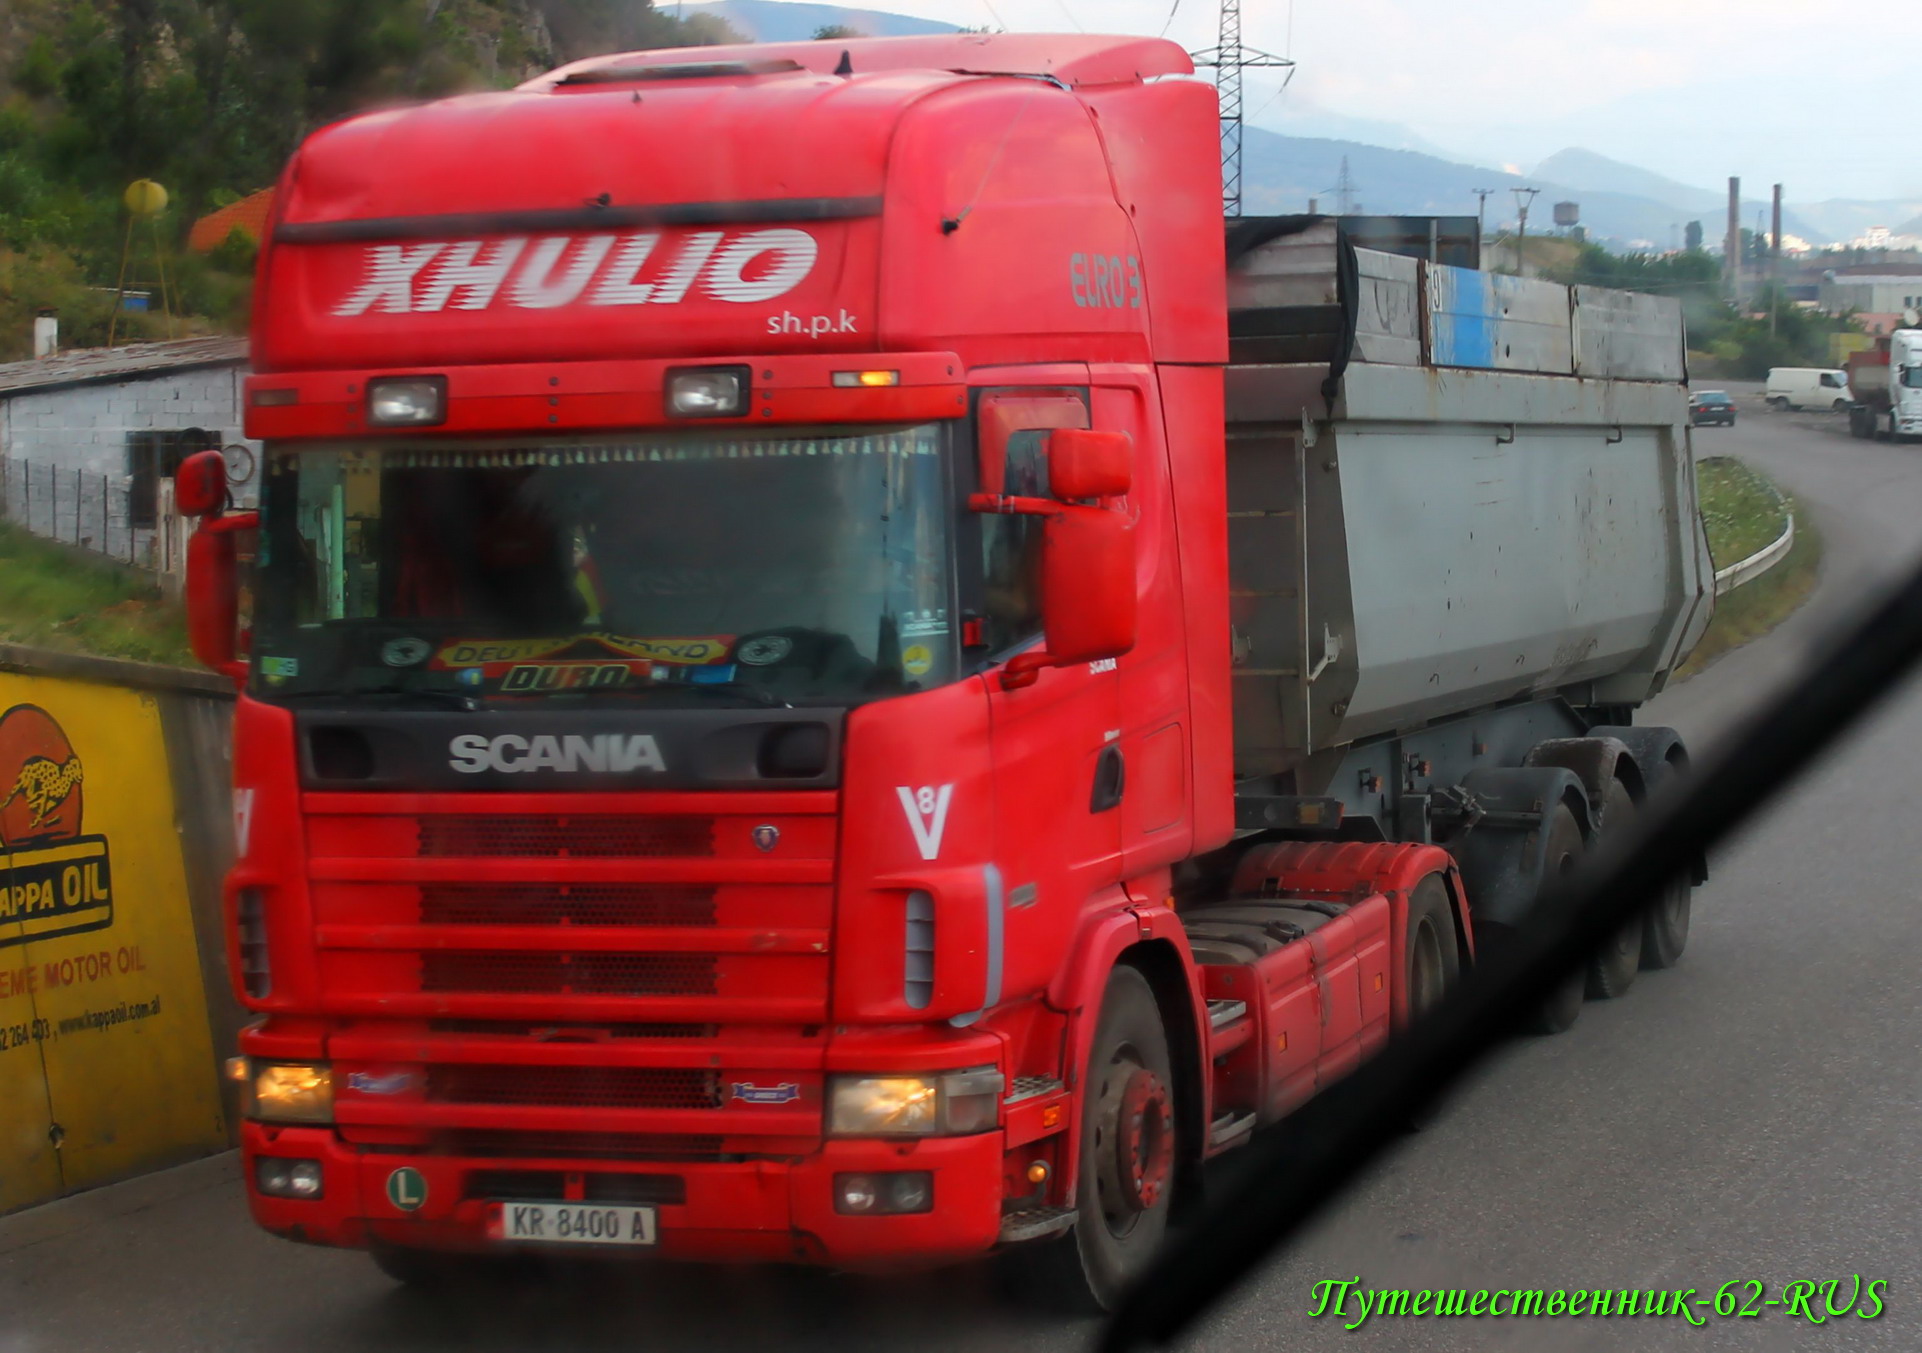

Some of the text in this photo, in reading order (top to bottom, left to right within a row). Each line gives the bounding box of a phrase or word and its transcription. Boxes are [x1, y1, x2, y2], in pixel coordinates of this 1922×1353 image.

[330, 228, 818, 316] XHULIO
[1070, 252, 1141, 309] EURO 3
[767, 308, 858, 339] sh.p.k
[448, 734, 667, 773] SCANIA
[62, 863, 108, 906] OIL
[45, 951, 112, 988] MOTOR
[117, 946, 145, 974] OIL
[397, 1171, 419, 1204] L
[513, 1206, 646, 1240] KR 8400 A
